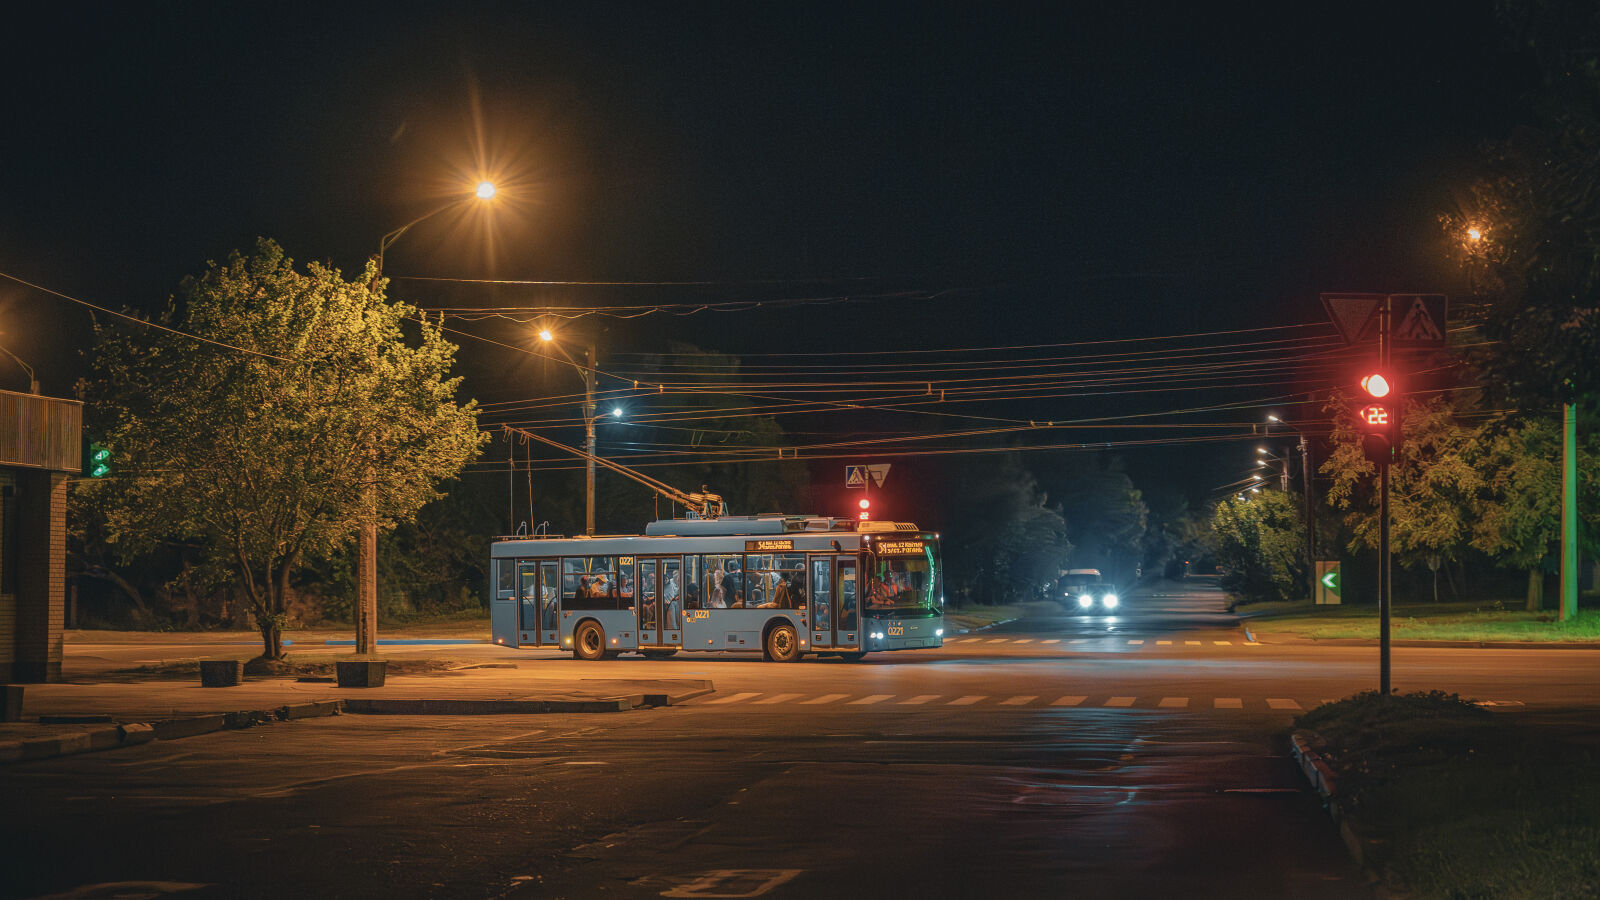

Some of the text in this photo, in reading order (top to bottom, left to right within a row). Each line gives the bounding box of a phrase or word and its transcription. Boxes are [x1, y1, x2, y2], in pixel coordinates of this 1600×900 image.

[1367, 407, 1388, 425] 22
[619, 556, 633, 565] 0221
[694, 609, 709, 618] 0221
[888, 626, 904, 636] 0221
